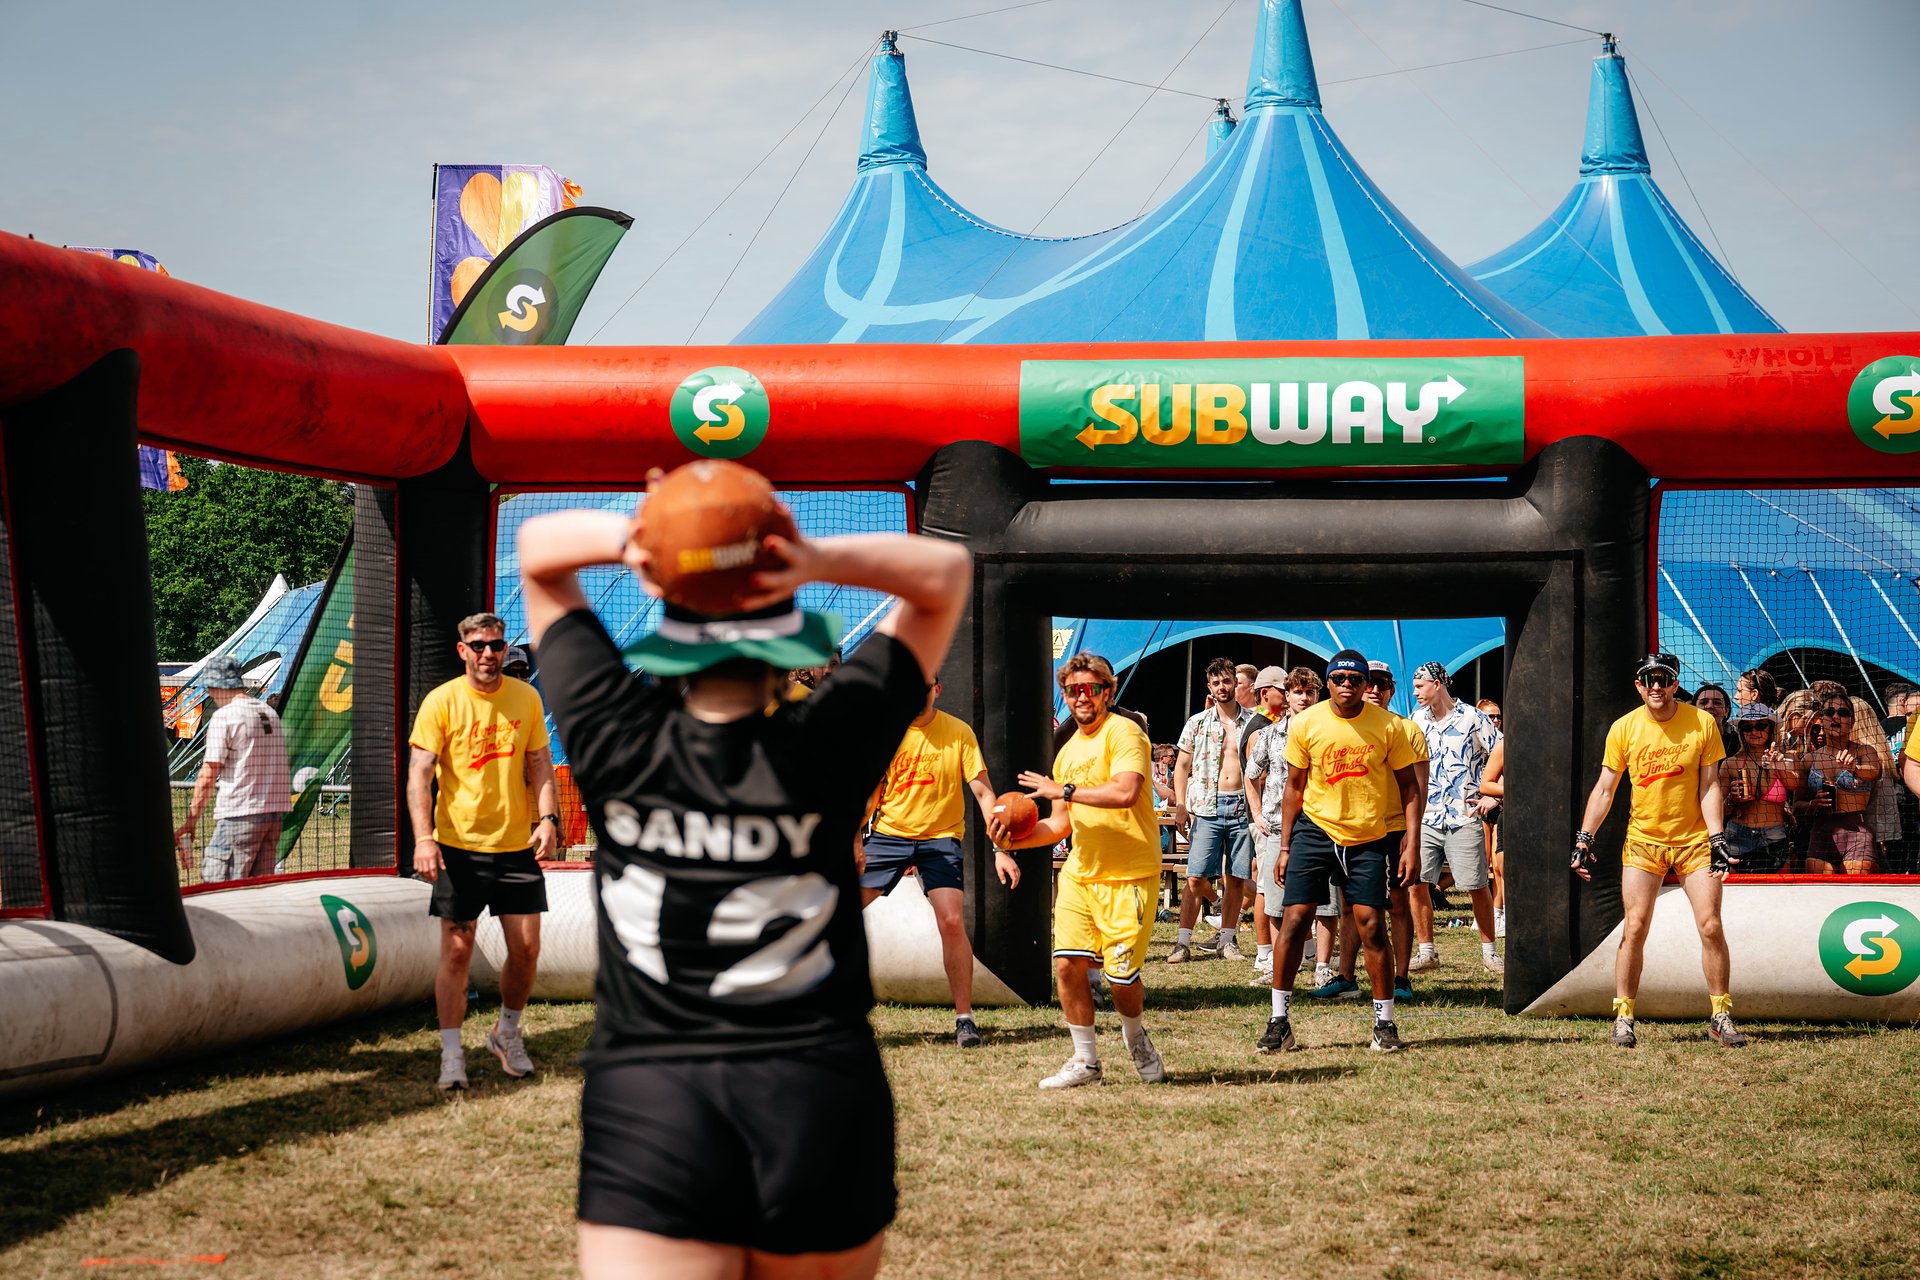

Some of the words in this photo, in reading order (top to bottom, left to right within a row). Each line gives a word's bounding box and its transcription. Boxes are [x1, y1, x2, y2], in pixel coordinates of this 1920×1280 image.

[1076, 374, 1467, 451] SUBWAY
[469, 720, 521, 750] Average
[1321, 742, 1374, 768] Average
[1636, 744, 1689, 770] Average
[604, 800, 822, 862] SANDY
[601, 864, 839, 1000] 12
